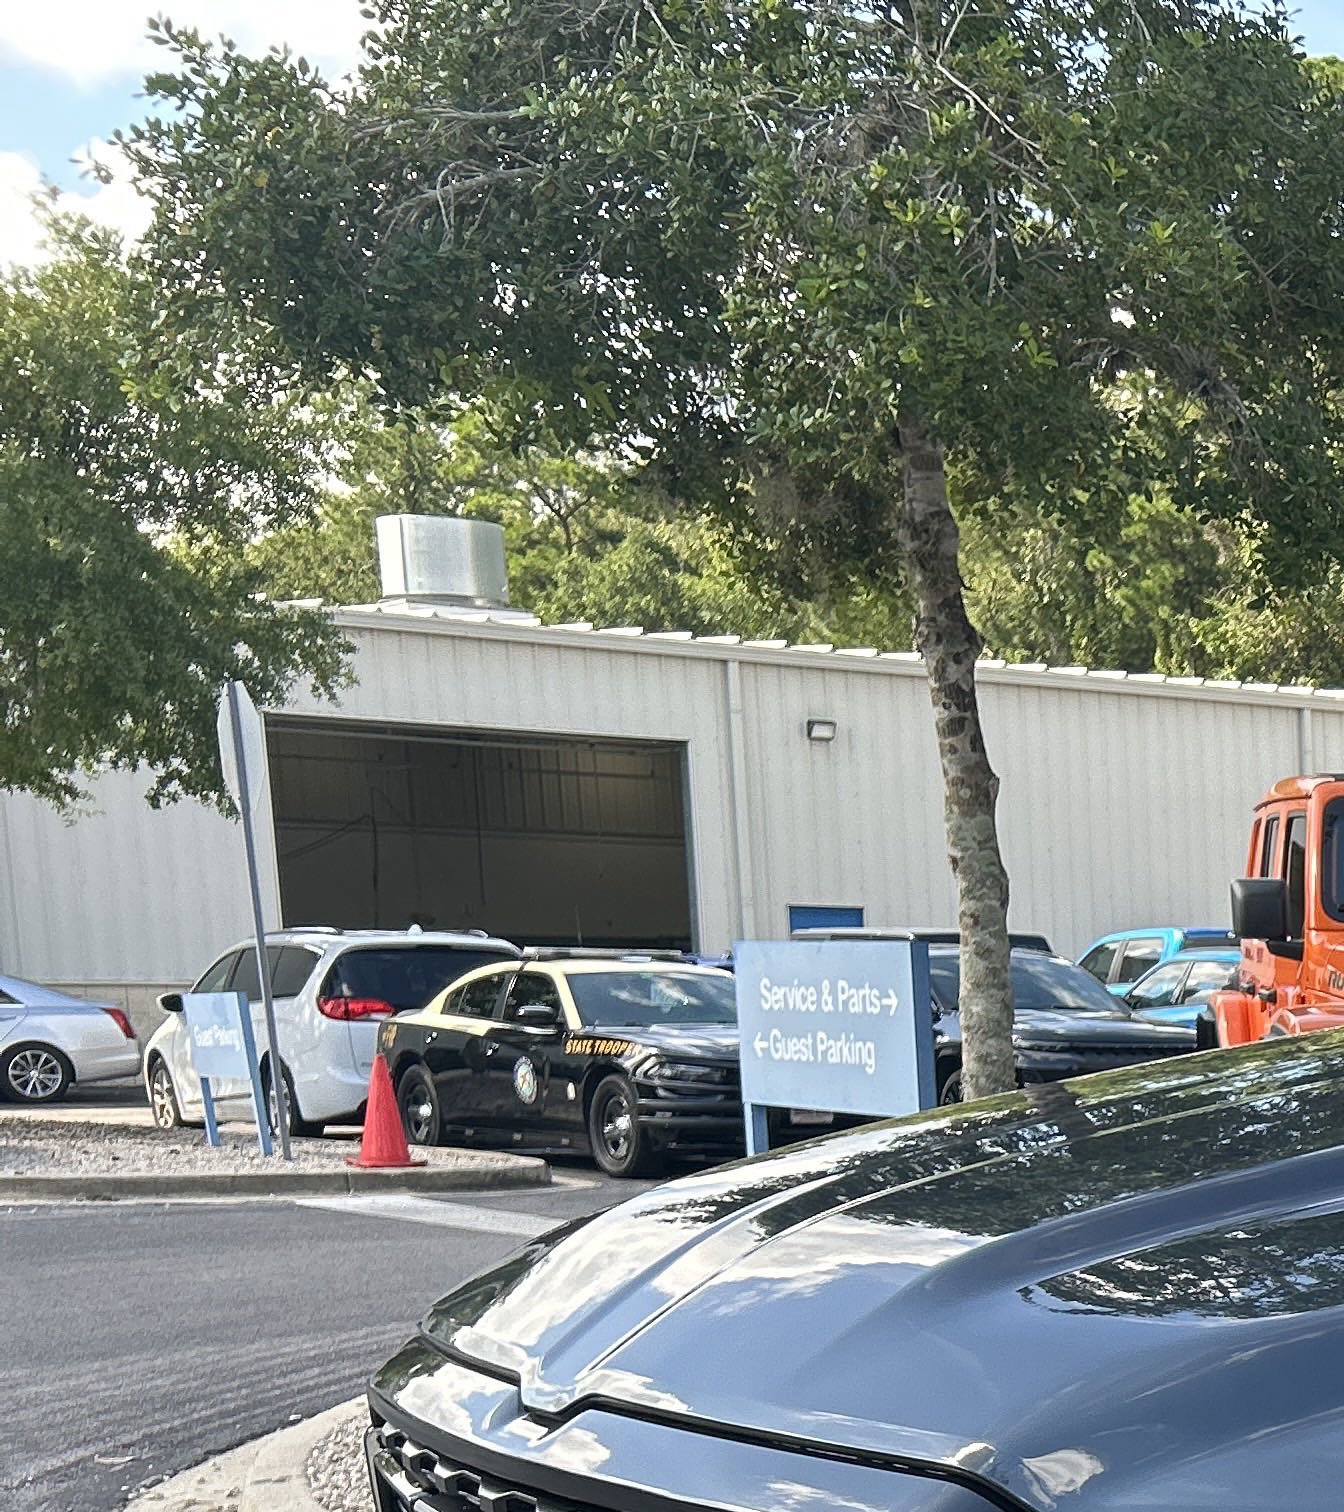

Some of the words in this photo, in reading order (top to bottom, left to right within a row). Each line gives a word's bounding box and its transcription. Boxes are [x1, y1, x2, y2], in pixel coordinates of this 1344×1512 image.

[759, 977, 818, 1012] Service
[821, 979, 834, 1013] &
[837, 979, 881, 1015] Parts
[565, 1039, 594, 1055] STATE
[593, 1039, 643, 1056] TROOPER
[769, 1028, 815, 1062] Guest
[816, 1031, 876, 1075] Parking
